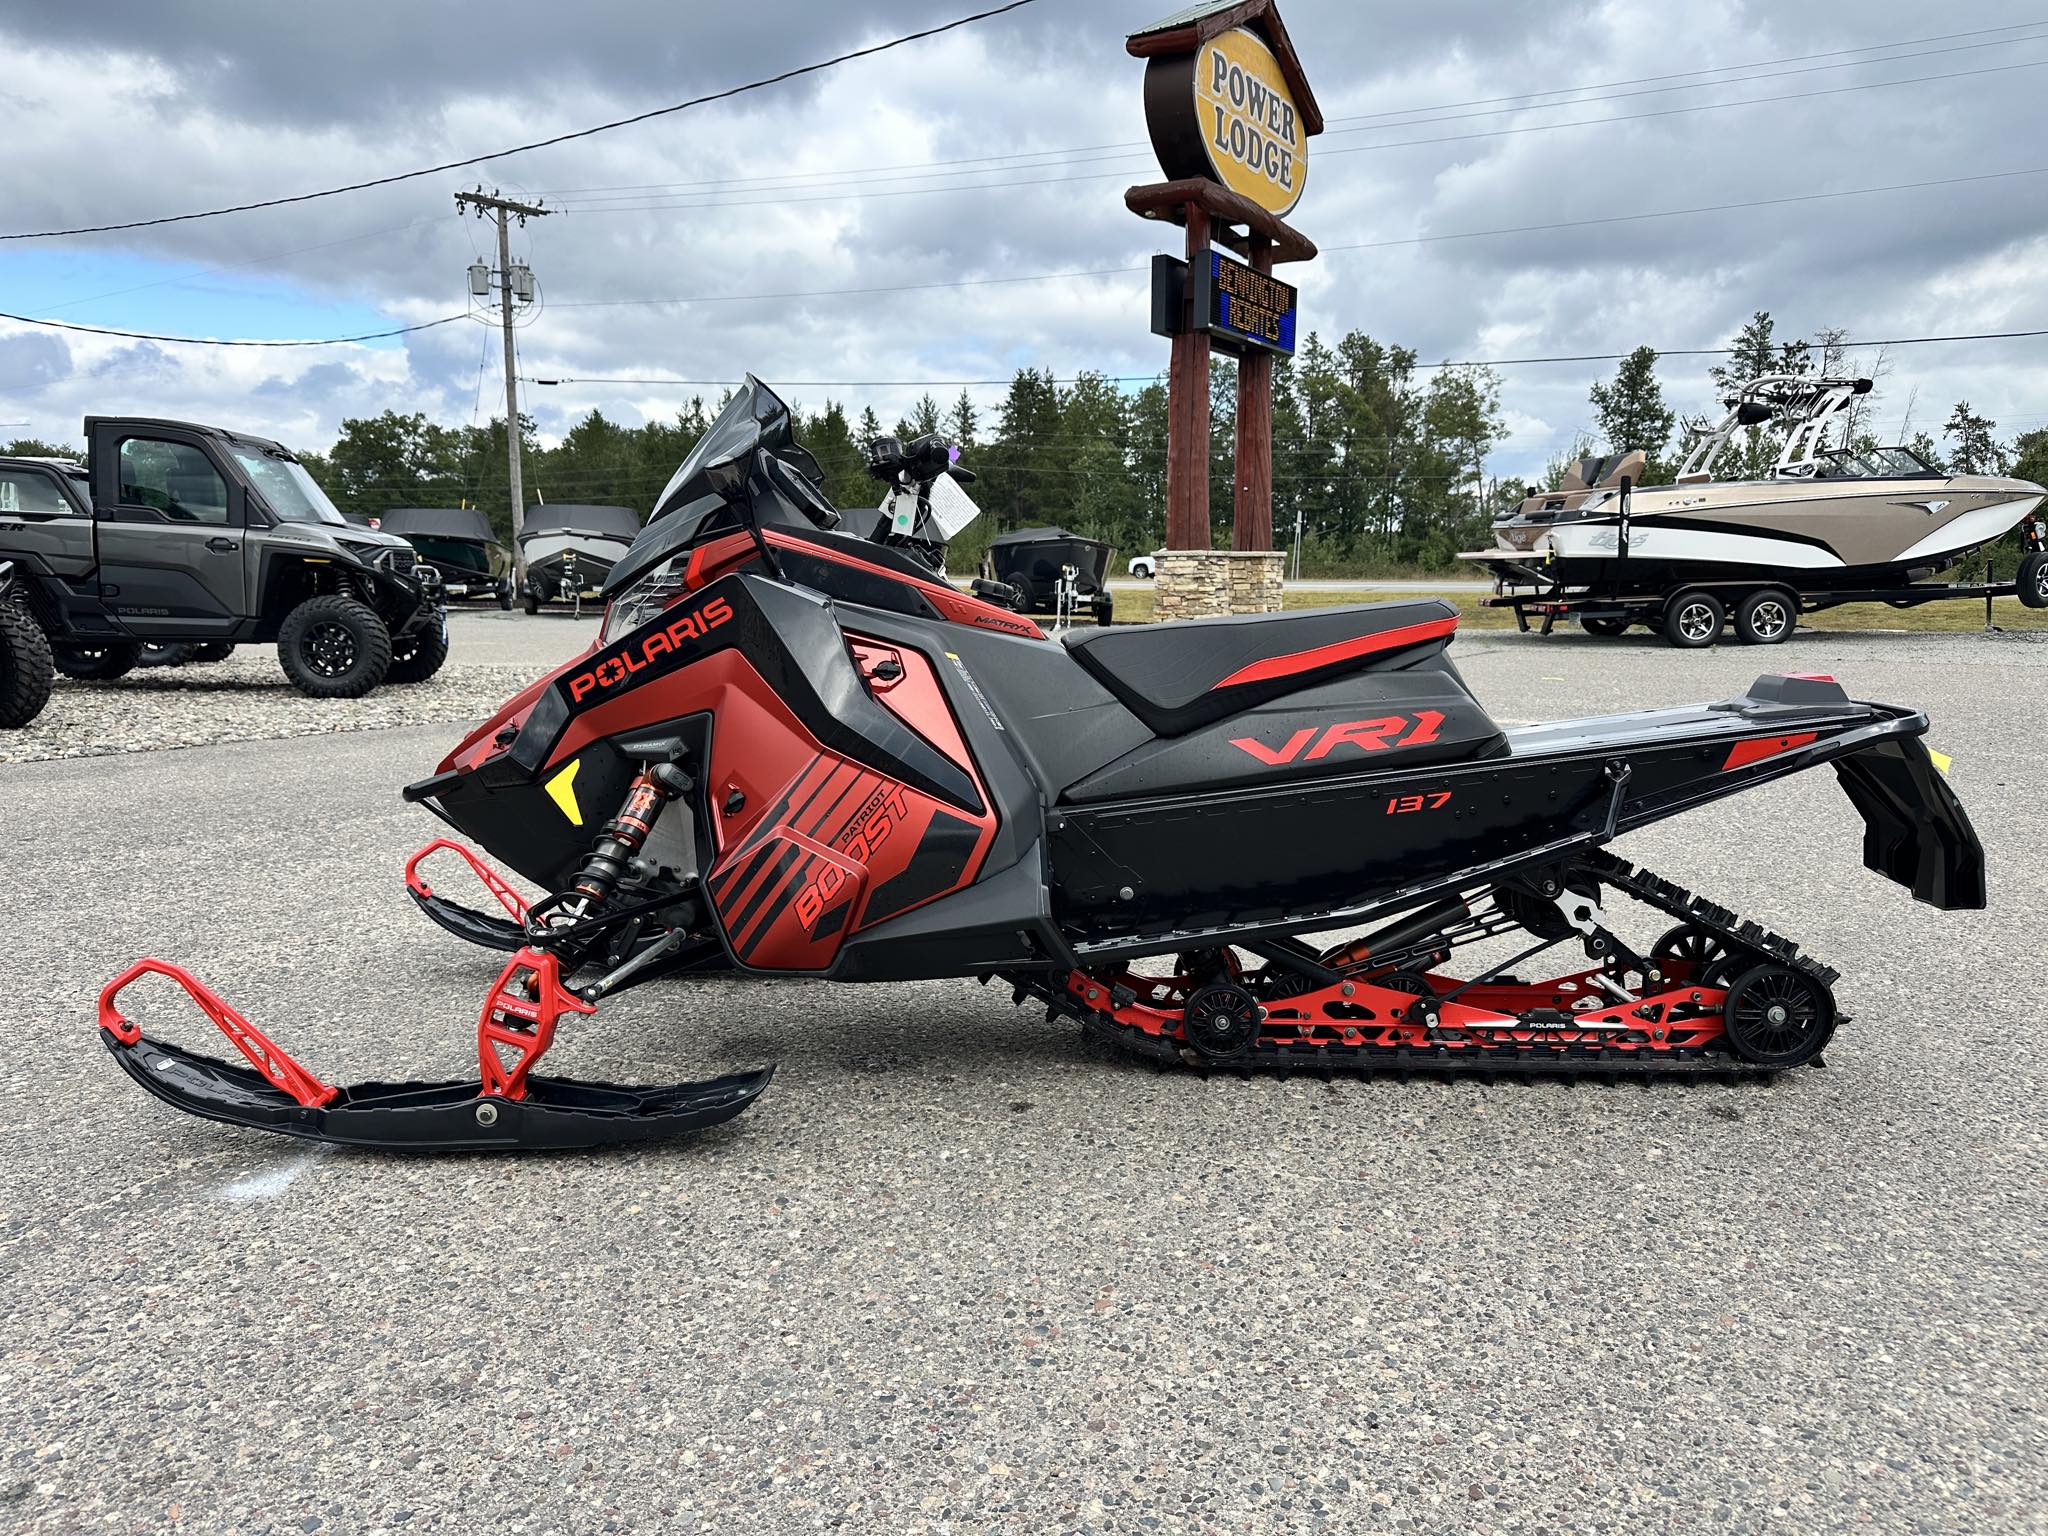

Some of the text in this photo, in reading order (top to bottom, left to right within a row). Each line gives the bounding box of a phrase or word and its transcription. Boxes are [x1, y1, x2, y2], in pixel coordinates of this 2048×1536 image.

[1212, 50, 1296, 146] POWER
[1214, 105, 1292, 190] LODGE
[1218, 259, 1289, 315] BENNINGTON
[1228, 295, 1279, 341] REBATES
[117, 607, 169, 616] POLARIS
[974, 615, 1032, 634] MATRYX
[569, 596, 734, 703] POLARIS
[1228, 710, 1446, 766] VR1
[841, 788, 886, 843] PATRIOT
[1386, 791, 1452, 815] 137
[794, 783, 908, 931] BOOST
[496, 1000, 538, 1018] POLARIS
